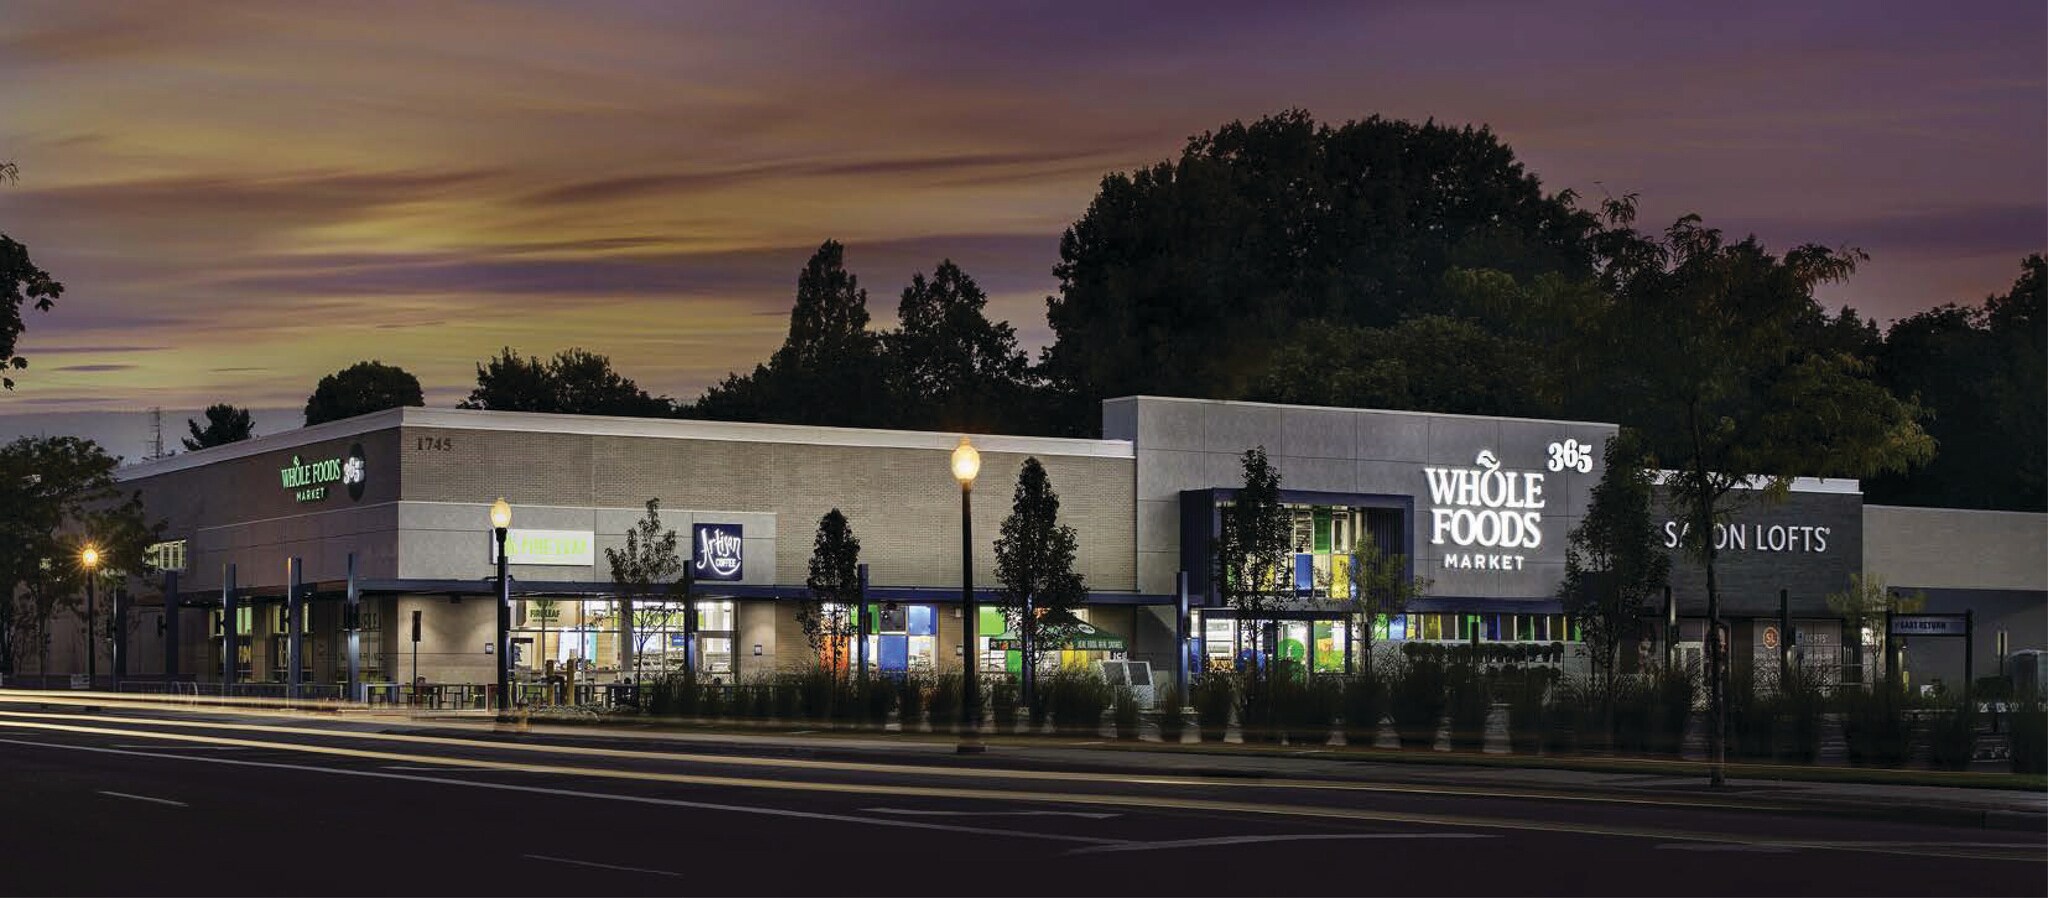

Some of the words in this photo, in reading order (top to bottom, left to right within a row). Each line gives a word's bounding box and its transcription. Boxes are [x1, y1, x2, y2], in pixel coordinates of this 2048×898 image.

[418, 437, 452, 451] 1745
[1548, 439, 1593, 473] 365
[281, 458, 311, 488] WHOLE
[312, 458, 340, 483] FOODS
[343, 457, 363, 485] 365
[1424, 455, 1545, 508] WHOLE
[296, 487, 324, 502] MARKET
[1431, 508, 1541, 548] FOODS
[696, 528, 742, 576] Artisan
[715, 558, 737, 567] COFFEE
[1444, 553, 1525, 570] MARKET
